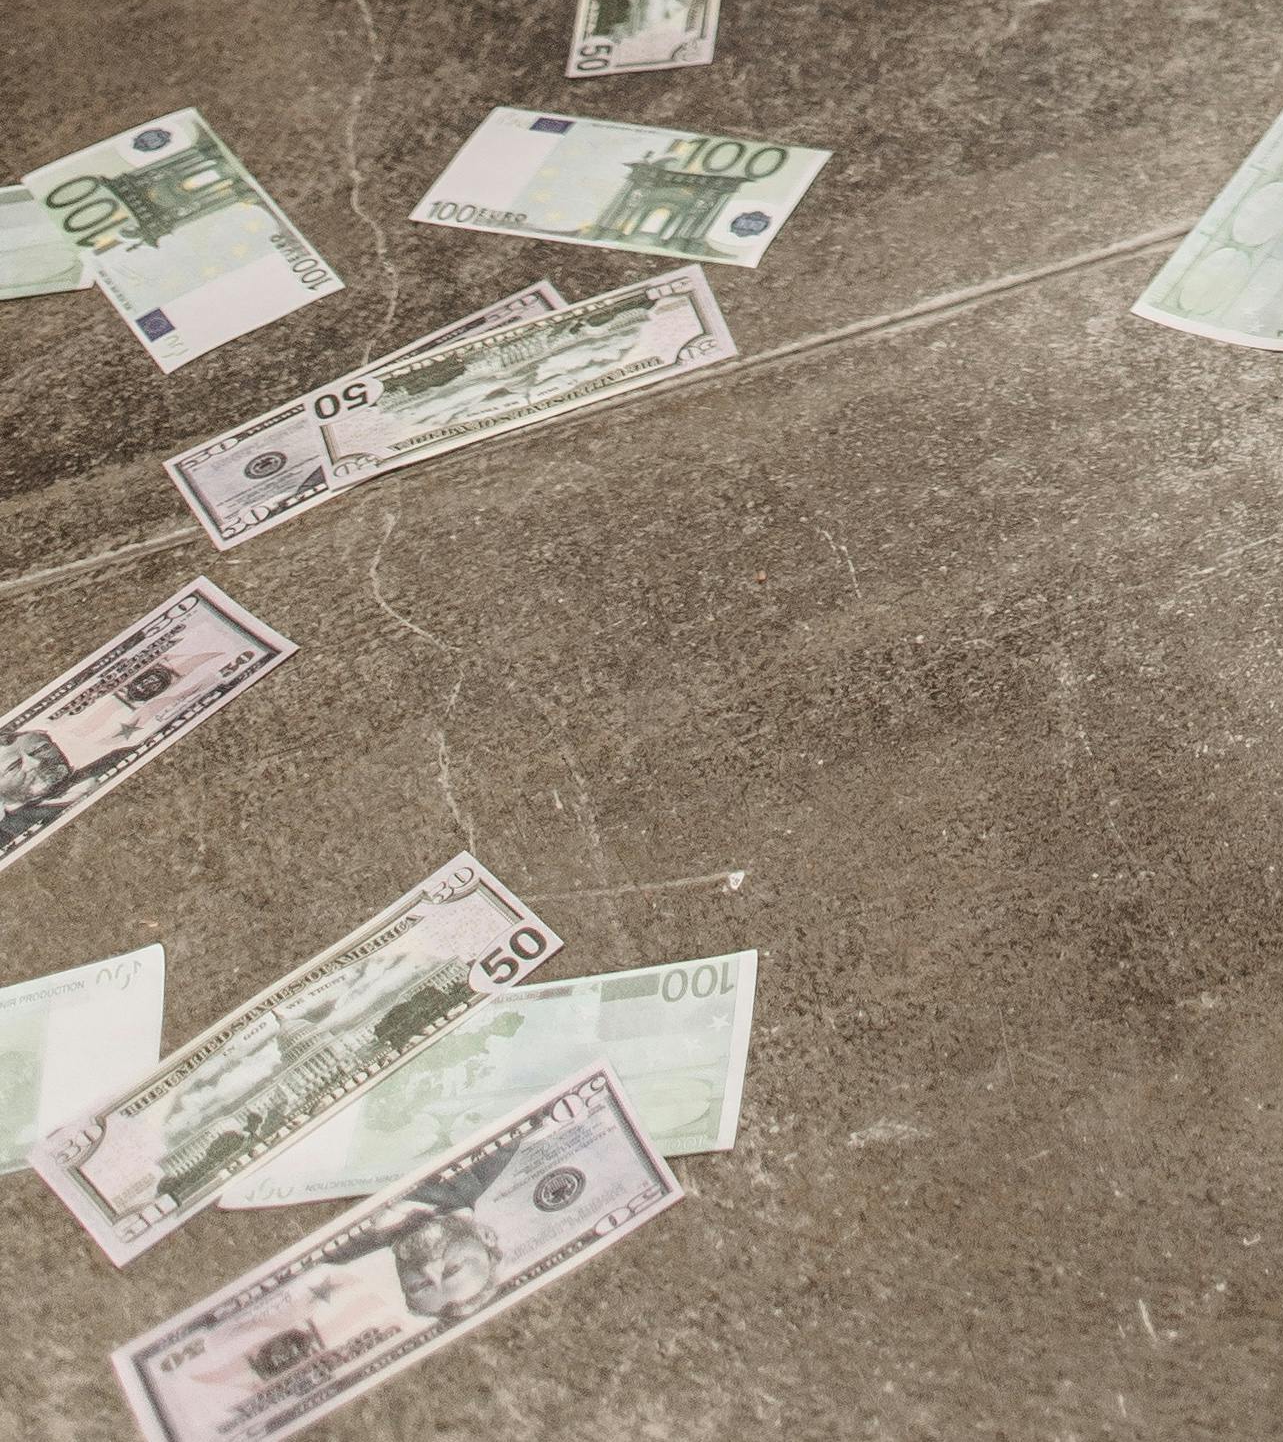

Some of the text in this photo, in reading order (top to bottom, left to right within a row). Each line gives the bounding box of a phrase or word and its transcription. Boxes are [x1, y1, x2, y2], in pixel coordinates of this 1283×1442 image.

[577, 42, 613, 71] 50
[673, 136, 793, 180] 100
[38, 170, 135, 251] 100
[420, 200, 477, 224] 100
[288, 255, 335, 293] 100
[311, 380, 371, 422] 50
[216, 503, 273, 539] 50
[139, 593, 202, 638] 50
[216, 649, 256, 678] 50
[473, 922, 555, 987] 50
[658, 959, 737, 1003] 100
[543, 1071, 614, 1128] 50
